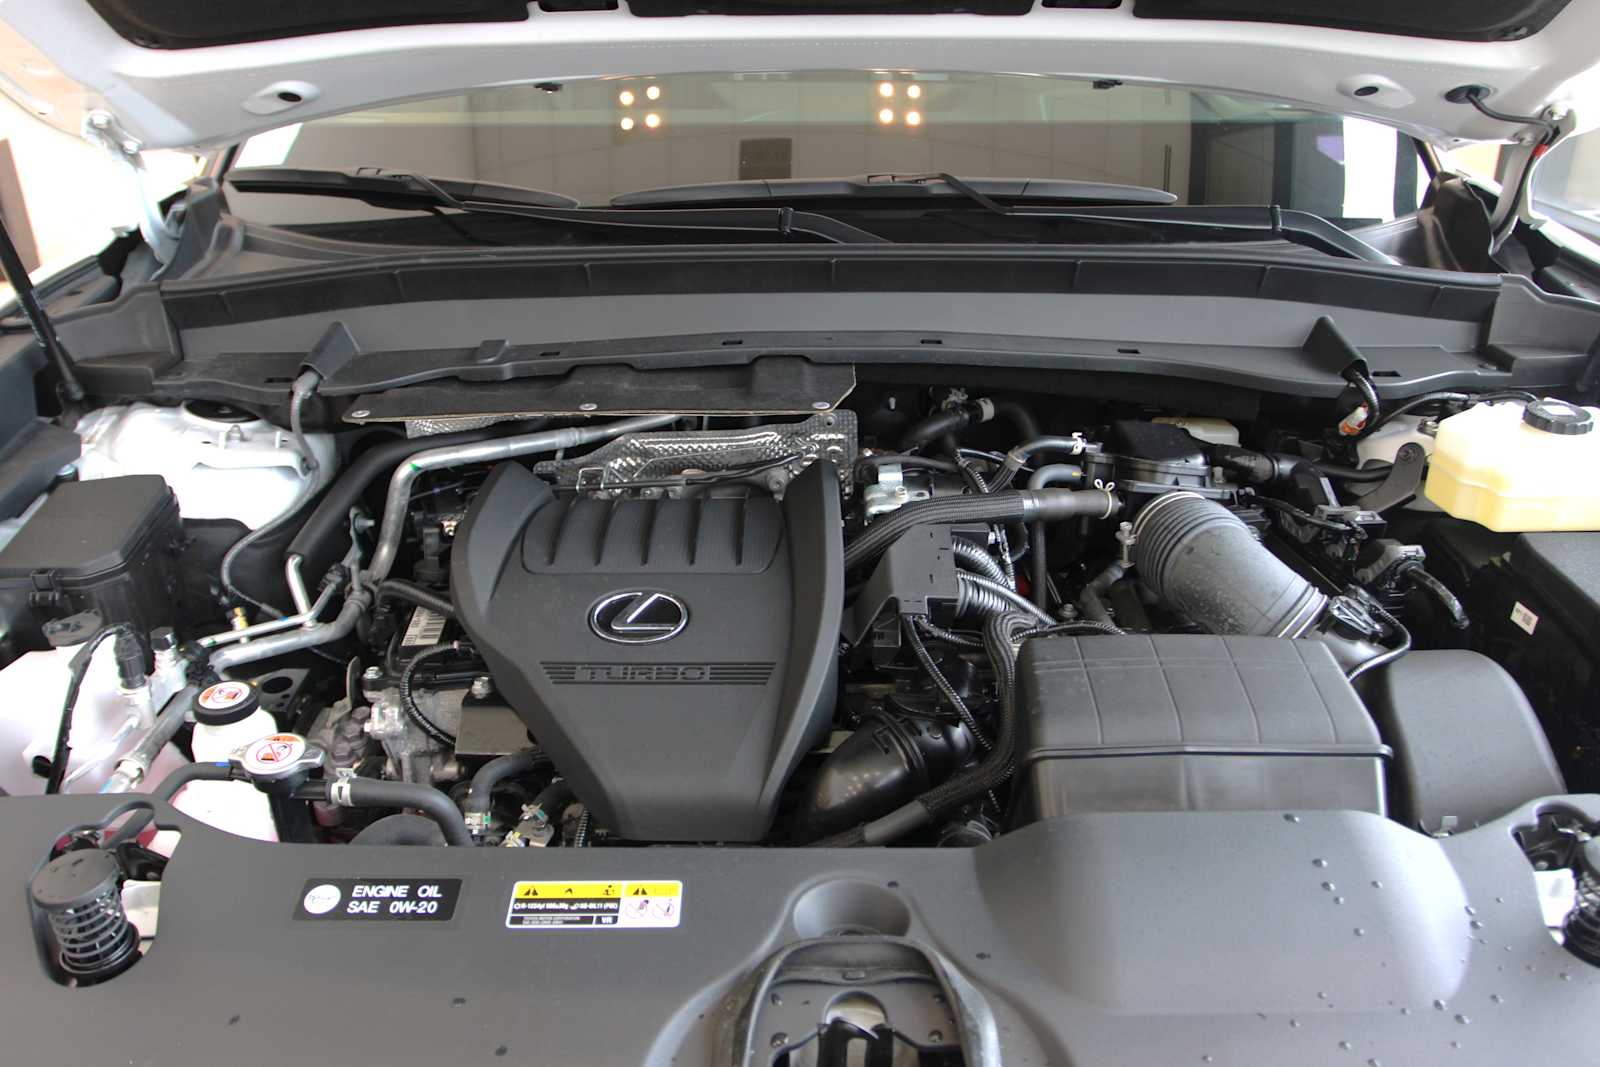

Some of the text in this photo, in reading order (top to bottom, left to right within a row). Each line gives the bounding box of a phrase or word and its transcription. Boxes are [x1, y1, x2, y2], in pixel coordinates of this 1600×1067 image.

[578, 666, 706, 681] TURBO
[351, 885, 443, 898] ENGINE OIL
[346, 901, 439, 914] SAE 0W-20
